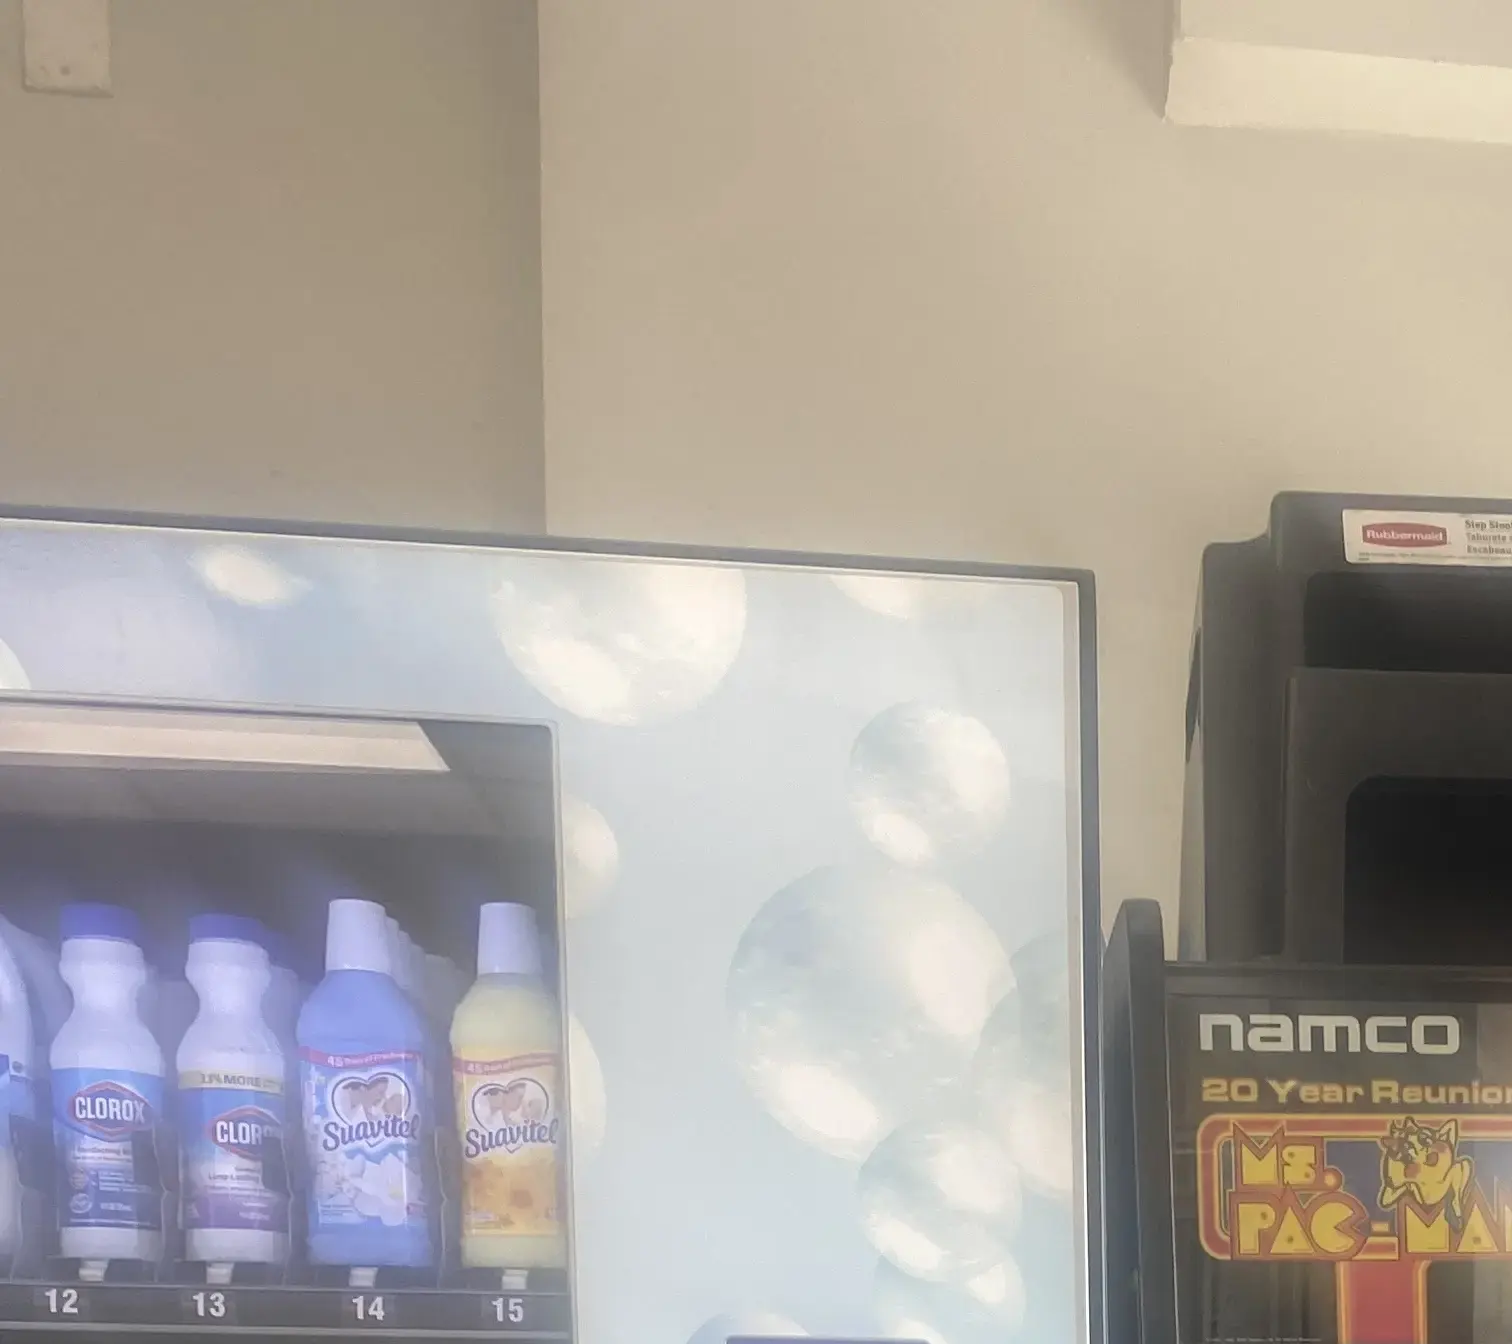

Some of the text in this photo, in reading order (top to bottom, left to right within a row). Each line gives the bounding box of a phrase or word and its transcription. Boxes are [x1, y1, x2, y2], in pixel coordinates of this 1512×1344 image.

[1366, 529, 1444, 542] Rubbermaid
[1464, 520, 1487, 531] Step
[1199, 1013, 1461, 1055] namco
[223, 1075, 262, 1088] MORE
[1201, 1077, 1258, 1103] 20
[1267, 1077, 1365, 1105] Year
[75, 1096, 145, 1122] CLOROX
[322, 1114, 420, 1151] Suavitel
[465, 1118, 559, 1159] Suavitel
[45, 1289, 79, 1315] 12
[193, 1293, 226, 1318] 13
[353, 1297, 385, 1321] 14
[491, 1298, 524, 1323] 15
